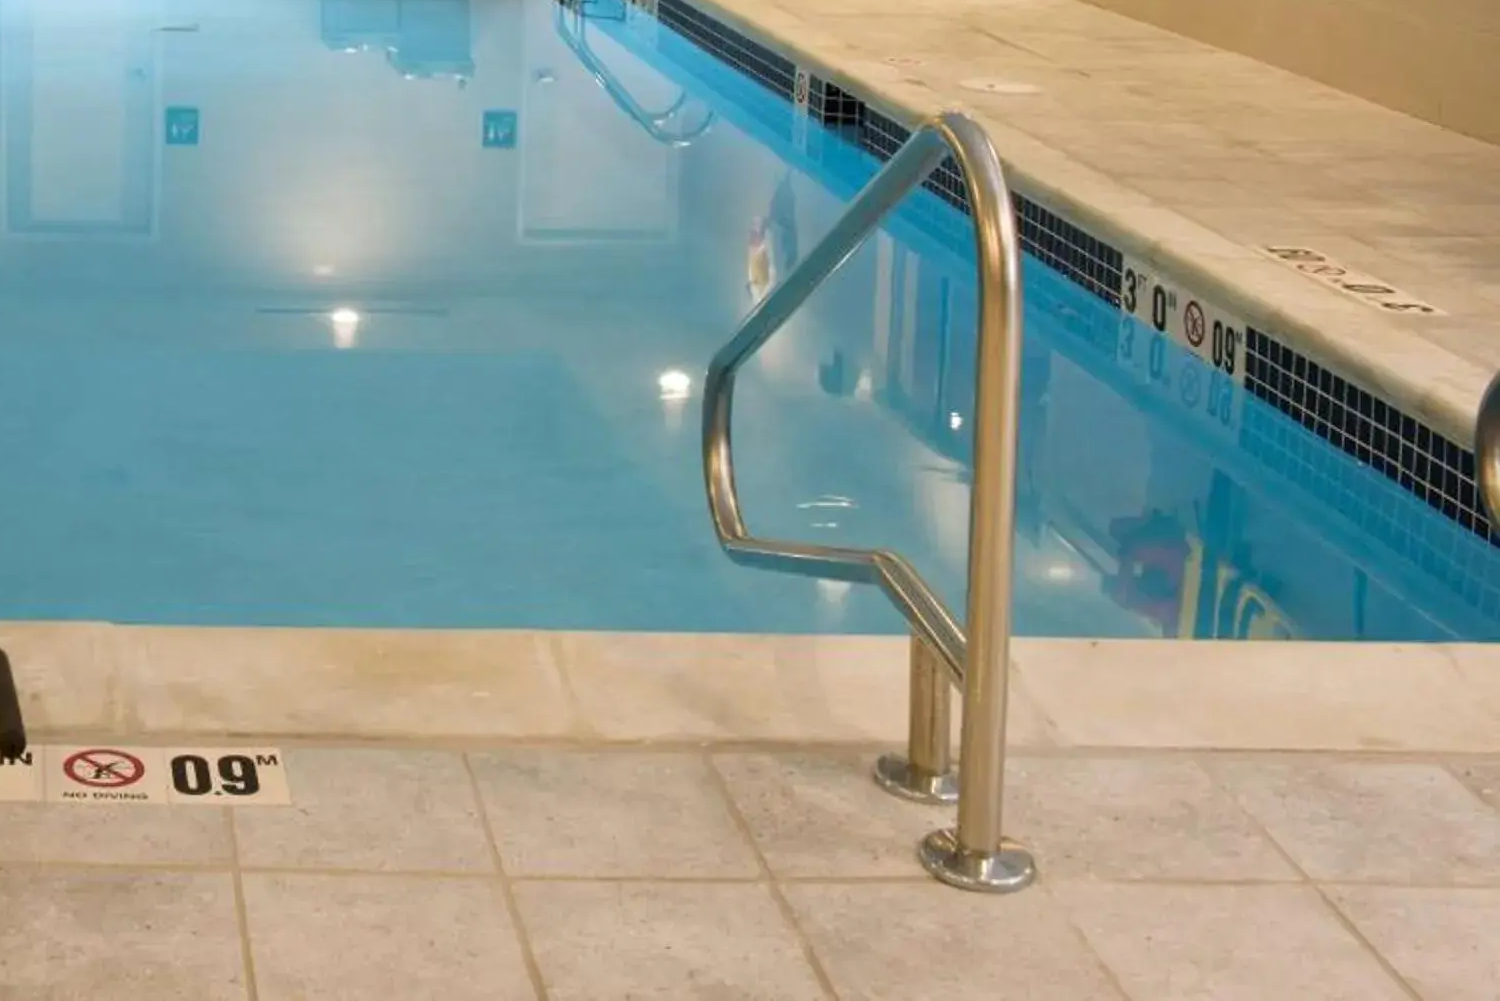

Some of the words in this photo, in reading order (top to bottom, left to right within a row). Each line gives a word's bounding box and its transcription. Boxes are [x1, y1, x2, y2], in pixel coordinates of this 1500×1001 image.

[1124, 268, 1136, 314] 3
[1153, 284, 1166, 331] 0
[93, 792, 149, 800] DIVING
